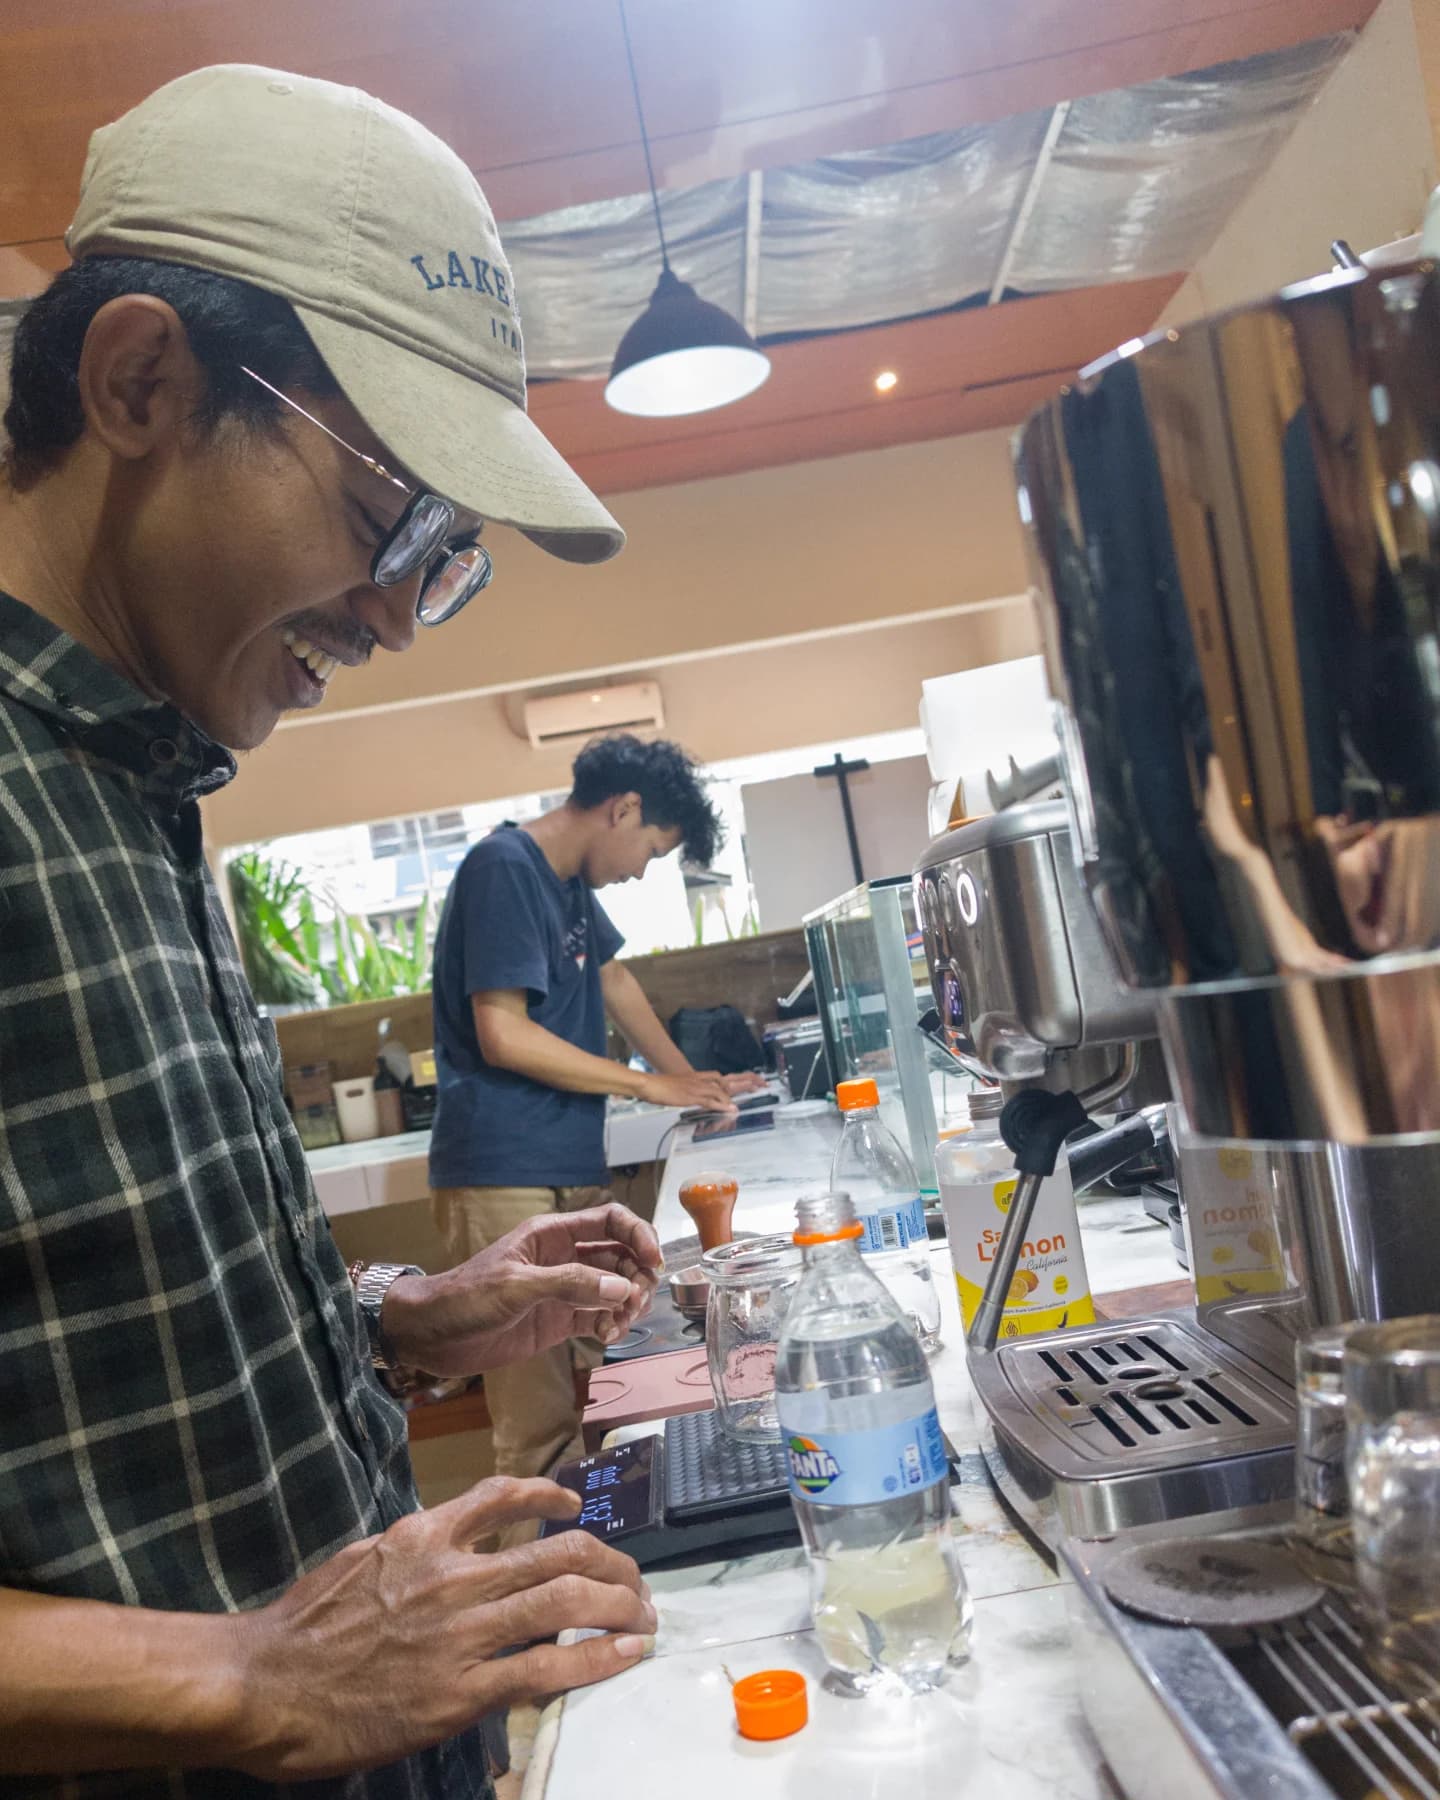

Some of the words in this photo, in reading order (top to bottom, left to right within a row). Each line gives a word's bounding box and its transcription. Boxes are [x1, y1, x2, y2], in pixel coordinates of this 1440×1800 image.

[410, 250, 510, 307] LAKE
[491, 318, 523, 353] ITA
[982, 1229, 1002, 1244] Sa
[788, 1448, 839, 1478] FANTA
